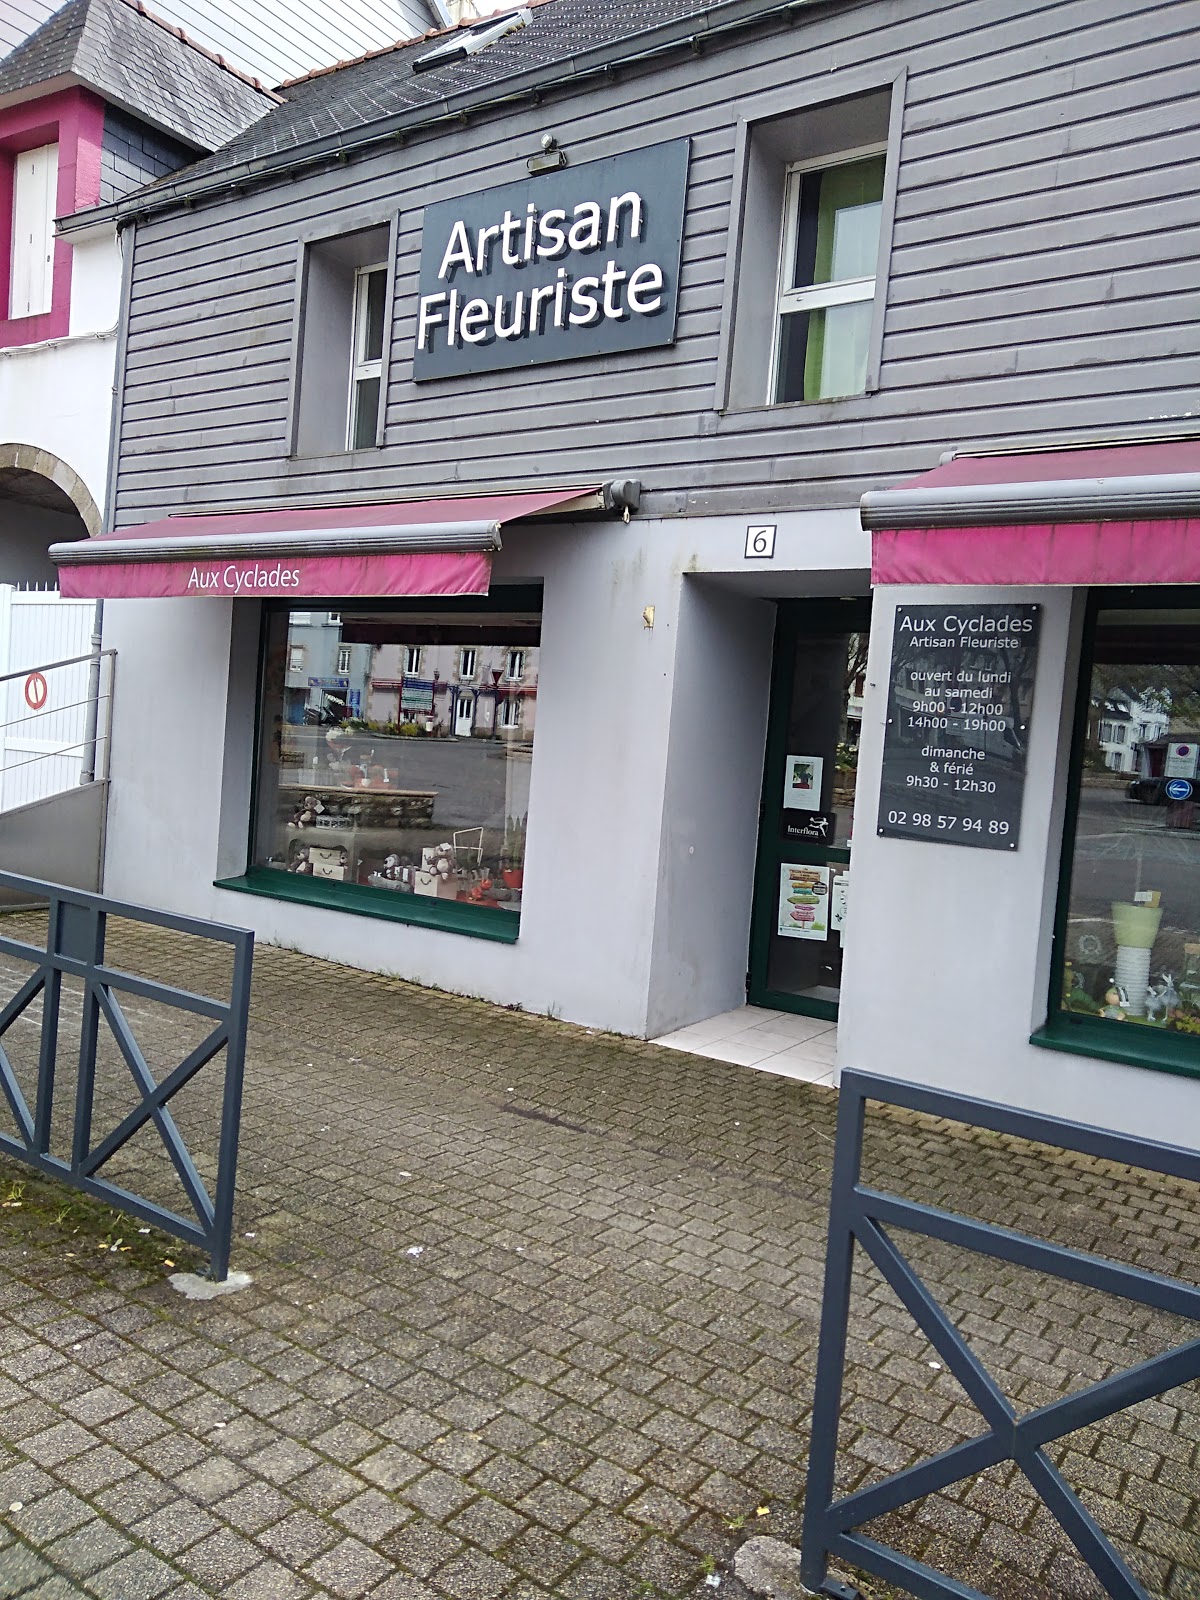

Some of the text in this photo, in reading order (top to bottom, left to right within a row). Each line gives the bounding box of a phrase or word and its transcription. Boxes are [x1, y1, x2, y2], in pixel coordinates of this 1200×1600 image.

[438, 191, 641, 279] Artisan
[418, 260, 663, 349] Fleuriste
[753, 530, 767, 553] 6
[188, 563, 300, 594] Aux Cyclades
[900, 615, 1033, 636] Aux Cyclades
[909, 636, 1019, 649] Artisan Fleuriste
[910, 670, 1011, 683] ouvert du lundi
[924, 686, 993, 699] au samedi
[912, 701, 945, 713] 9h00
[961, 703, 1003, 716] 12h00
[907, 717, 948, 729] 14h00
[964, 718, 1006, 732] 19h00
[921, 745, 986, 760] dimanche
[930, 761, 974, 775] & férié
[906, 775, 939, 789] 9h30
[954, 779, 996, 793] 12h30
[888, 810, 1010, 835] 02 98 57 94 89
[787, 825, 819, 836] Interflora
